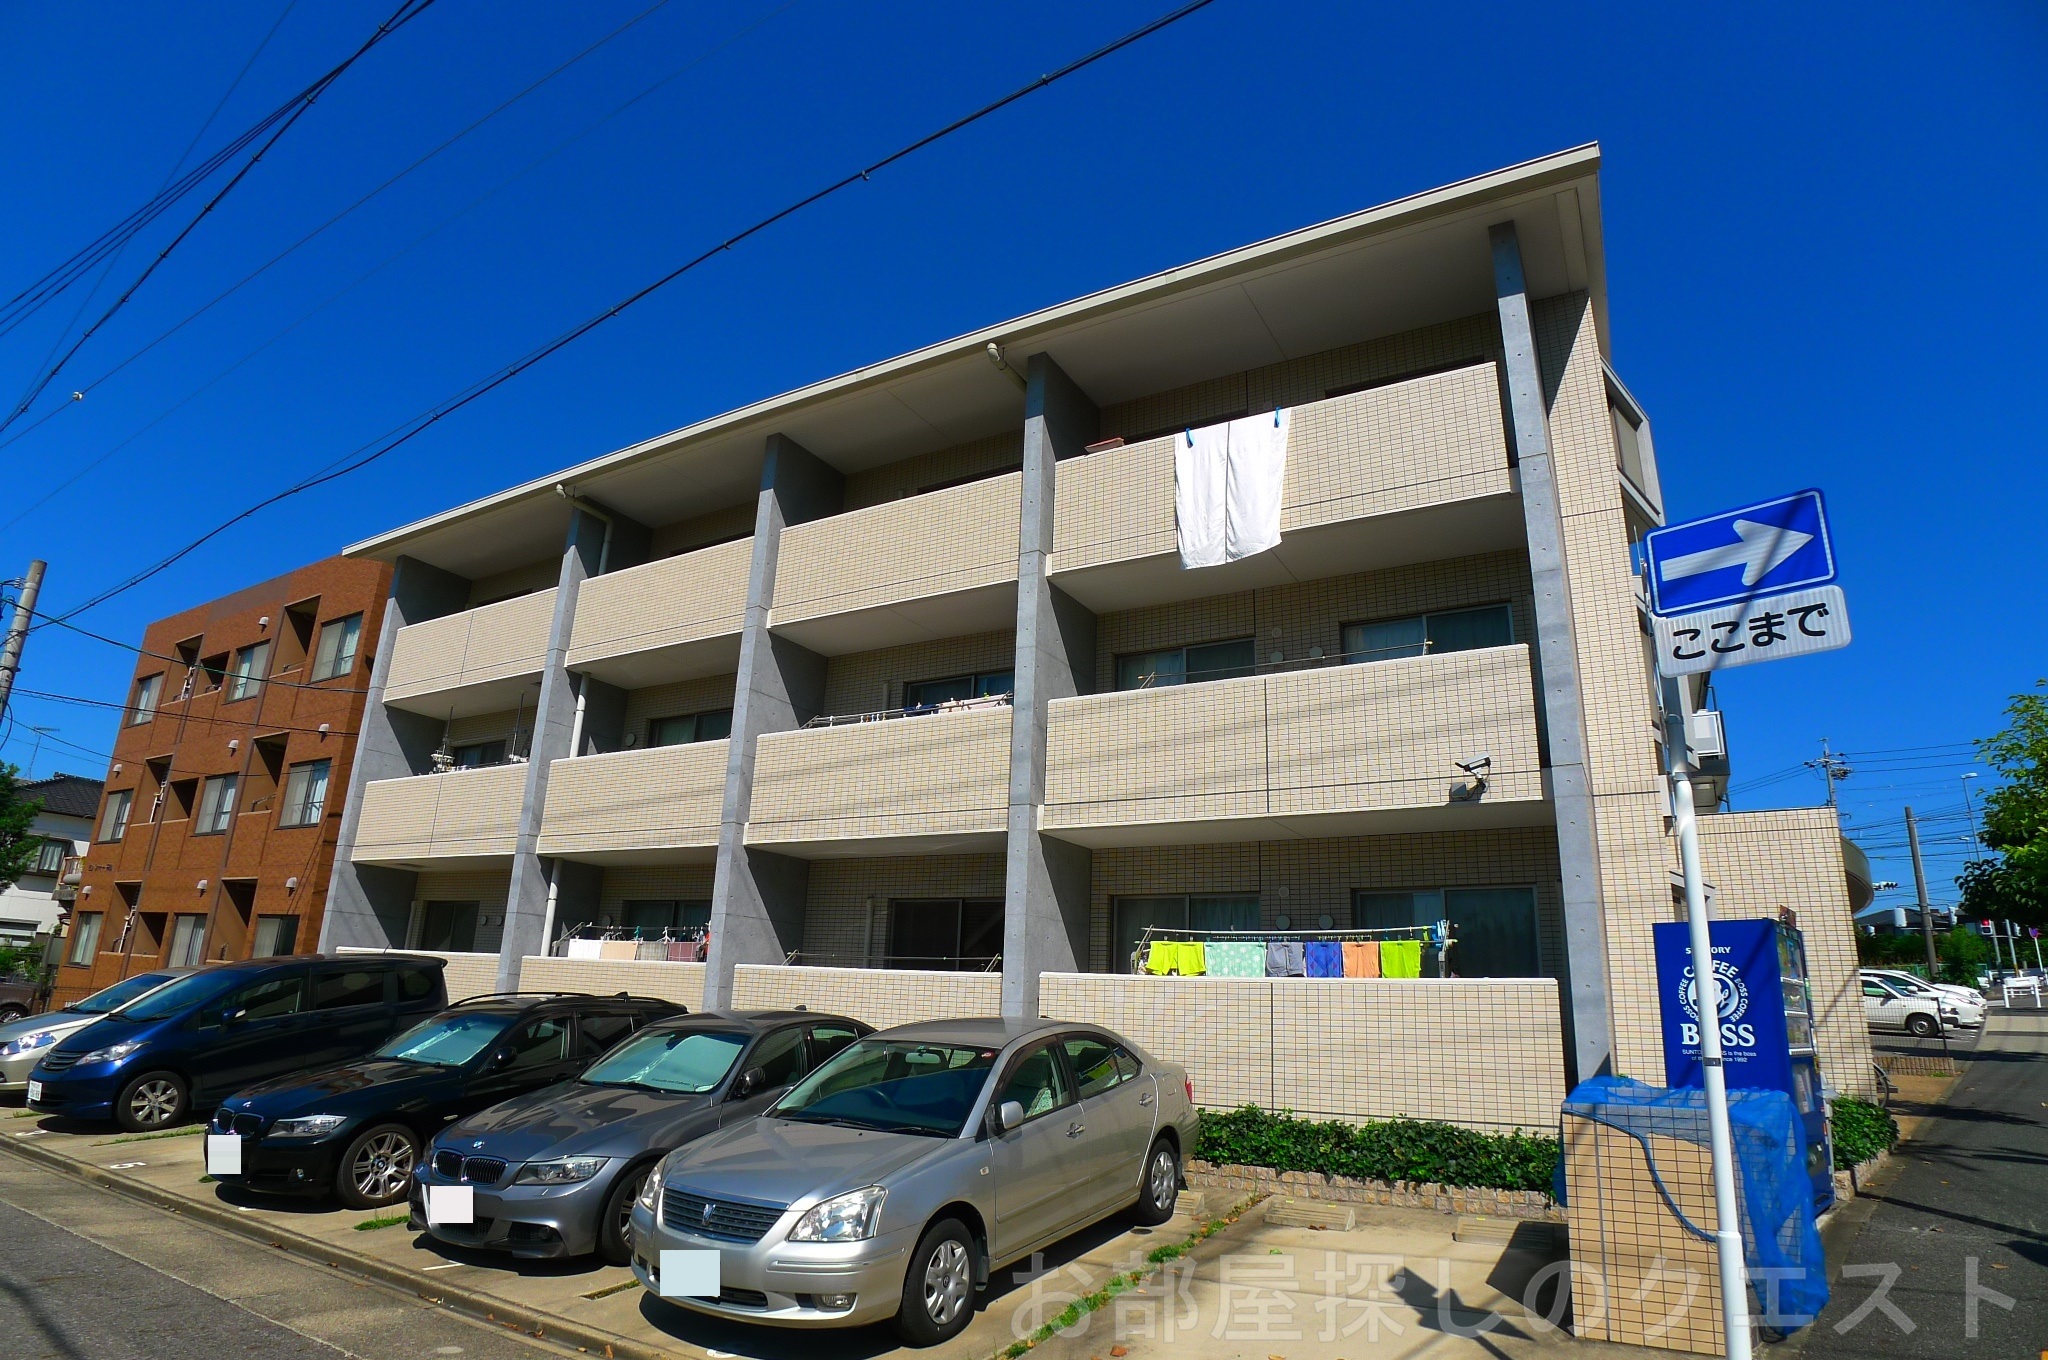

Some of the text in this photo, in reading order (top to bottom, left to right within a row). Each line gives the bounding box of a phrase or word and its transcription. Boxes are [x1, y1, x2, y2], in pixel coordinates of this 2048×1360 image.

[1672, 602, 1829, 660] ここまで
[1685, 946, 1731, 954] SORY
[1683, 959, 1739, 978] CFEE
[1678, 978, 1689, 1004] COFFEE
[1729, 978, 1748, 1022] BOSS COFFEE
[1680, 1023, 1756, 1047] BSS
